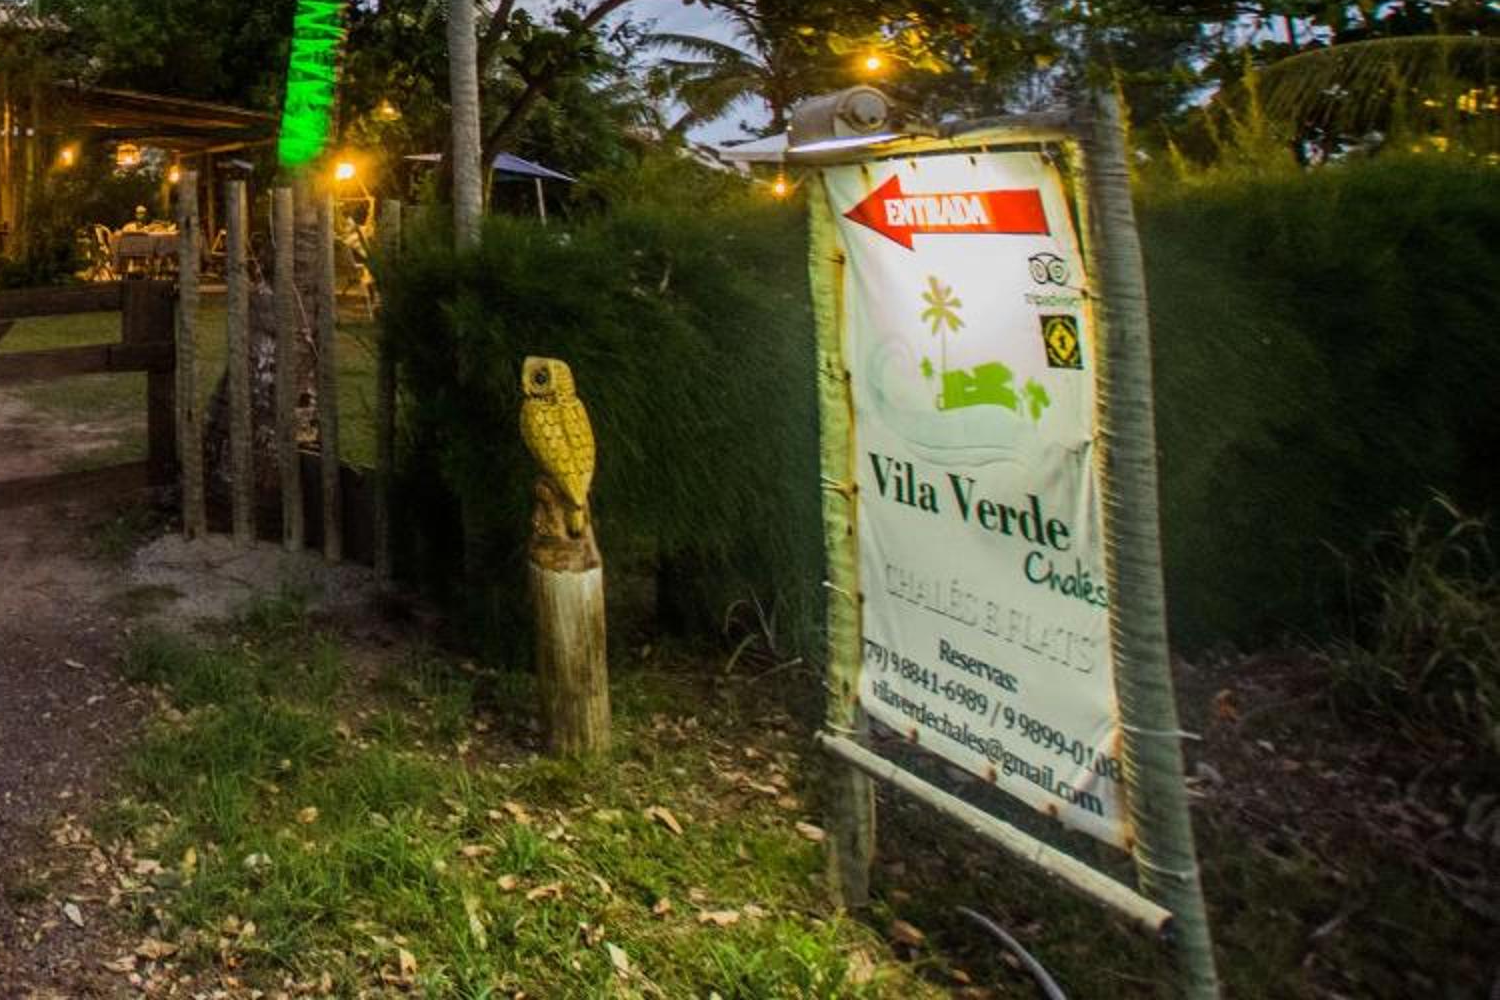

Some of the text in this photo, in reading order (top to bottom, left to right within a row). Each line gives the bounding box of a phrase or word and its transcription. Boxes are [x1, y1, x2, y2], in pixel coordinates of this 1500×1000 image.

[884, 195, 991, 227] ENTRADA
[867, 451, 1071, 551] Vila Verde
[1024, 551, 1109, 608] Chalés
[861, 637, 889, 672] 79)
[939, 638, 1019, 694] Reservas:
